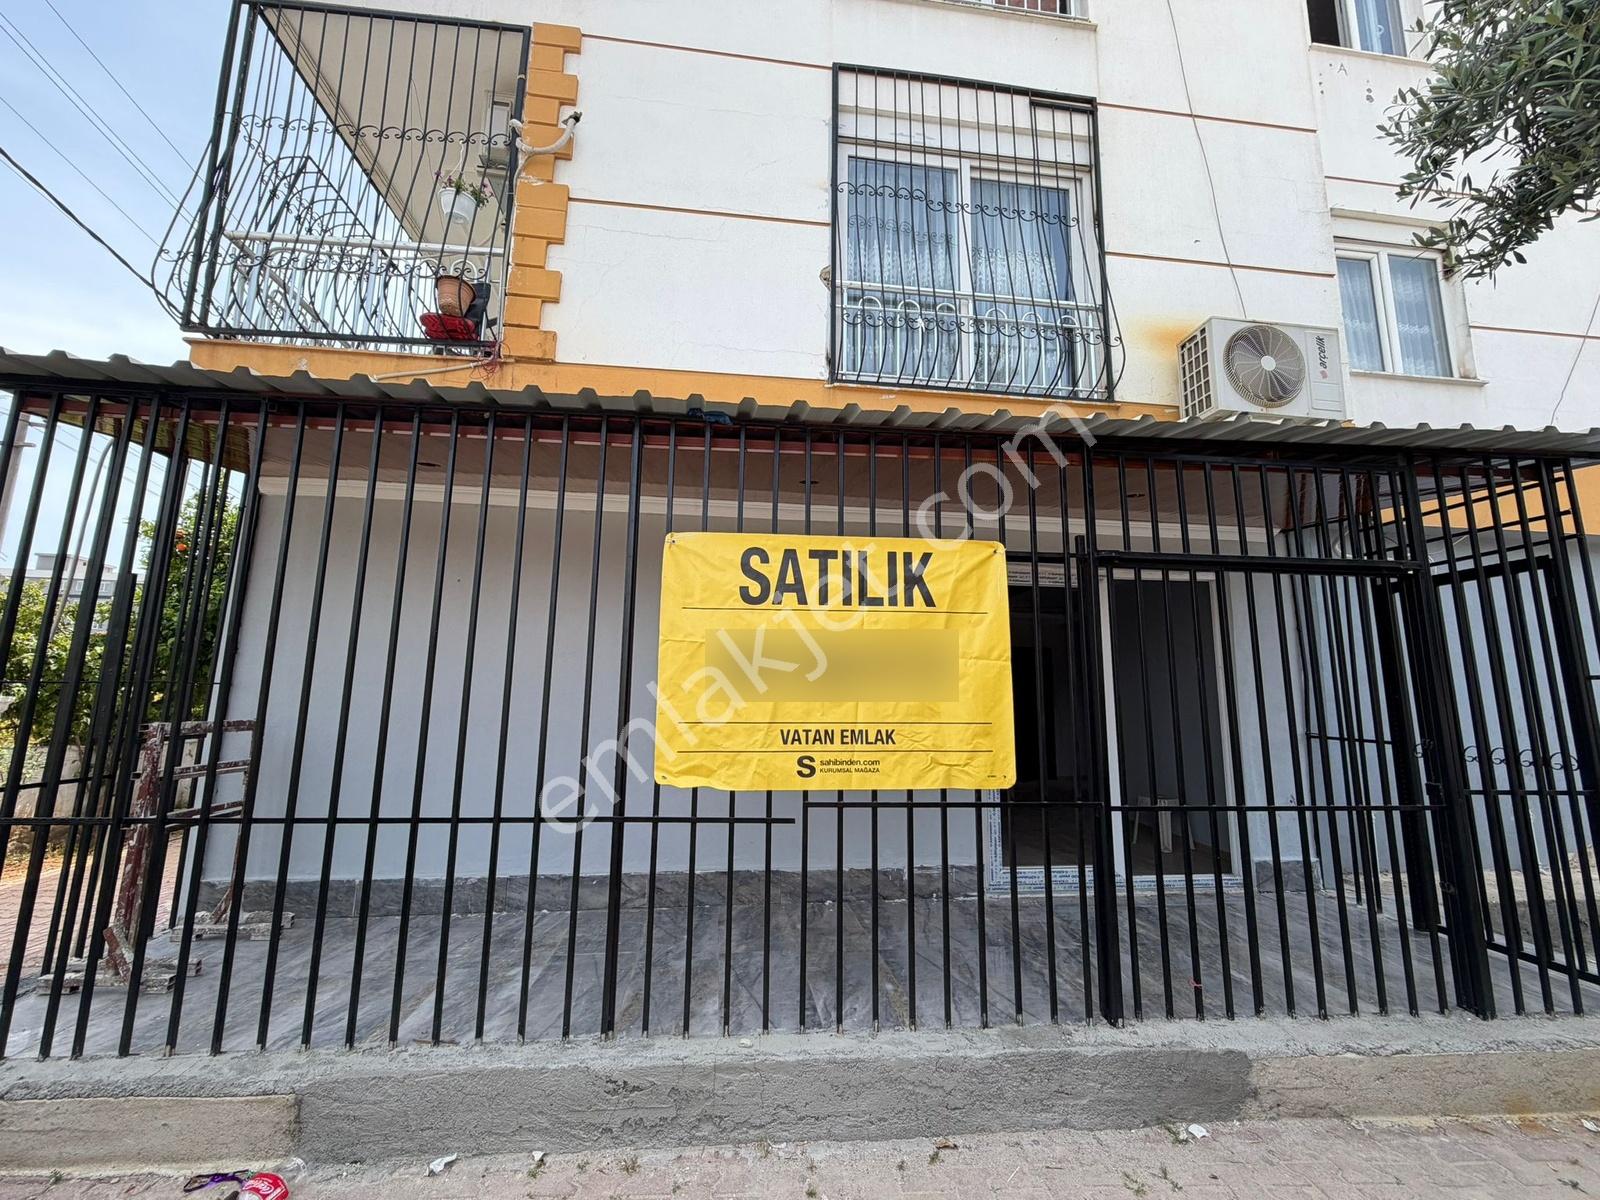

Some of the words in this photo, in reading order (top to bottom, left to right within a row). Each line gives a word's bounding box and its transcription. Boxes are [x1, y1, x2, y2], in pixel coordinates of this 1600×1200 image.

[1315, 335, 1328, 369] arçelik
[739, 546, 936, 607] SATILIK
[780, 729, 835, 745] VATAN
[840, 729, 896, 745] EMLAK
[819, 758, 880, 766] sahibinden.com
[854, 766, 880, 774] MAĞAZA
